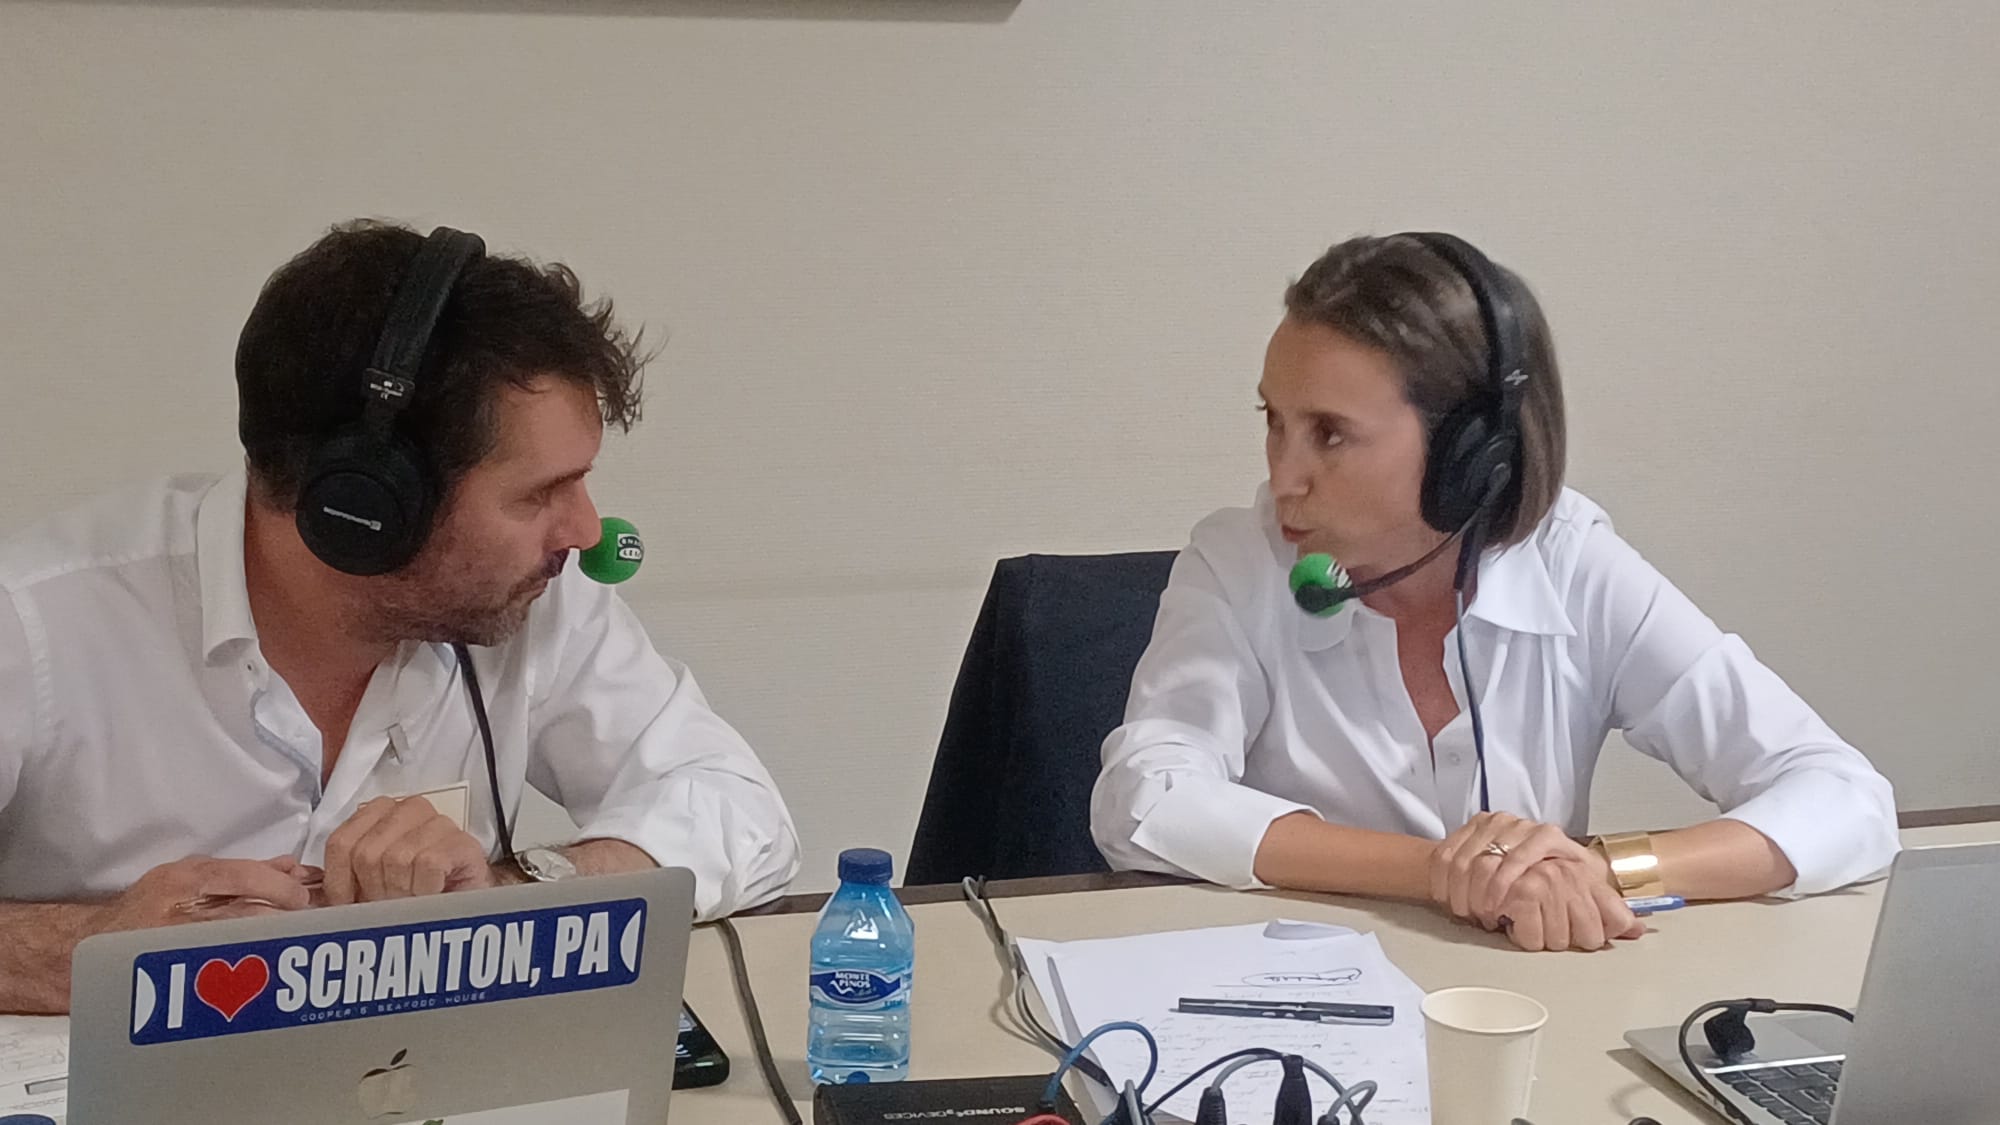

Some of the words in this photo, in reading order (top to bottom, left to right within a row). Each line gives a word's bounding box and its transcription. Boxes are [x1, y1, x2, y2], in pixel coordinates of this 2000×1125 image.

[167, 963, 186, 1029] I
[276, 920, 541, 1013] SCRANTON,
[551, 911, 609, 978] PA
[835, 972, 870, 980] MONTE
[839, 979, 871, 988] PINOS
